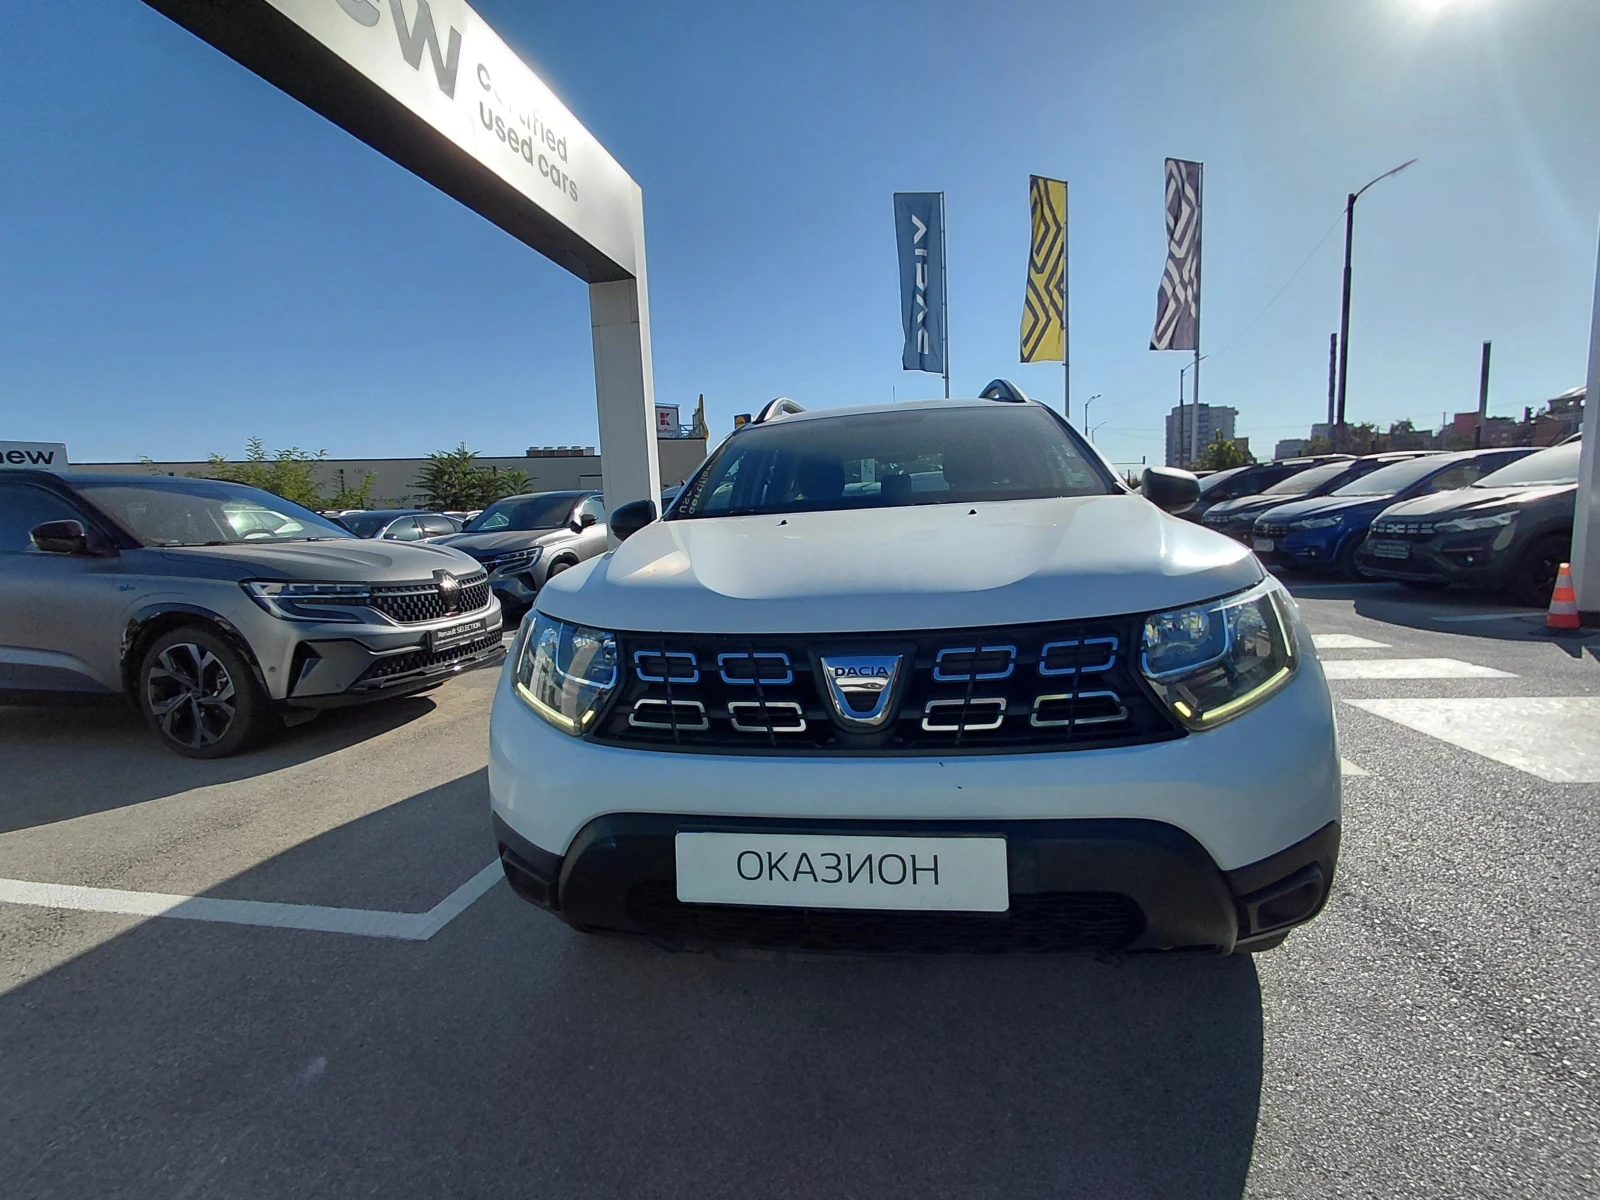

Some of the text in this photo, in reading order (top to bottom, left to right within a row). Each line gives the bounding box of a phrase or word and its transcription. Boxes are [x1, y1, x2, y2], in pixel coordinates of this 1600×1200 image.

[479, 100, 578, 202] used cars
[834, 665, 888, 677] DACIA
[736, 849, 939, 886] ОКАЗИОН
